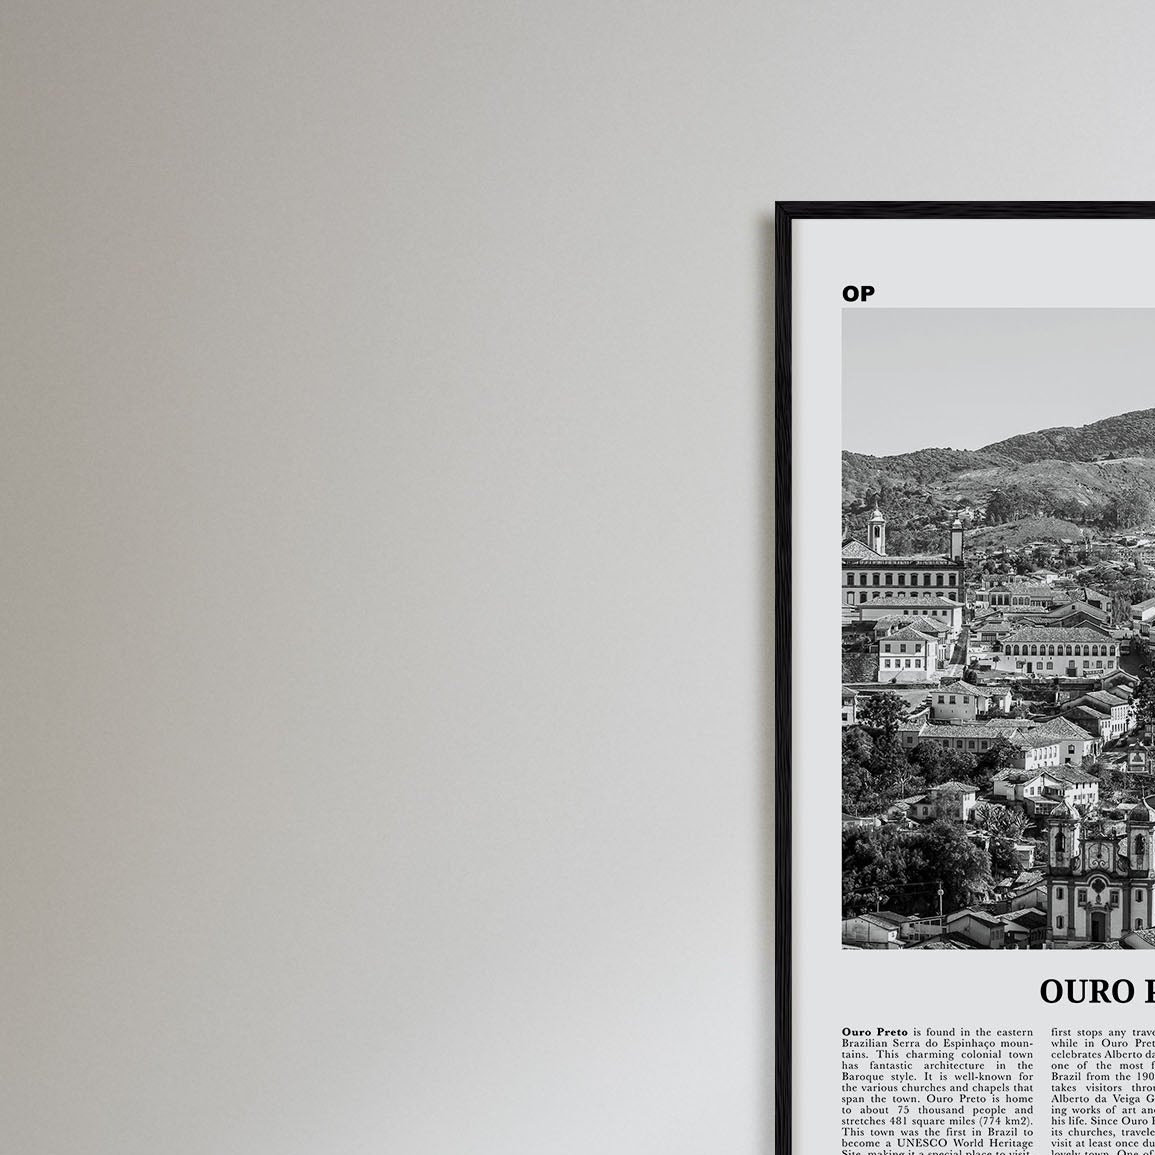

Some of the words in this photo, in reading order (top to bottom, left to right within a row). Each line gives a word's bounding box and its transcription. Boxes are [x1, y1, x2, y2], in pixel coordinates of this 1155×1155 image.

[842, 285, 875, 303] OP
[1040, 979, 1135, 1004] OURO
[842, 1028, 872, 1036] Ouro
[877, 1028, 909, 1036] Preto
[913, 1028, 922, 1036] is
[926, 1028, 956, 1036] found
[960, 1028, 971, 1036] in
[976, 1028, 992, 1036] the
[1051, 1028, 1071, 1036] first
[1077, 1029, 1103, 1039] stops
[1108, 1030, 1127, 1039] any
[842, 1039, 888, 1047] Brazilian
[893, 1039, 920, 1047] Serra
[925, 1039, 938, 1047] do
[943, 1039, 996, 1050] Espinhaço
[1051, 1039, 1078, 1047] while
[1085, 1039, 1095, 1047] in
[1101, 1039, 1129, 1047] Ouro
[842, 1050, 869, 1059] tains.
[876, 1050, 899, 1059] This
[906, 1050, 955, 1061] charming
[961, 1050, 1002, 1059] colonial
[1009, 1051, 1033, 1059] town
[1051, 1050, 1102, 1059] celebrates
[1104, 1050, 1143, 1059] Alberto
[842, 1061, 859, 1070] has
[870, 1061, 913, 1070] fantastic
[924, 1061, 985, 1070] architecture
[996, 1061, 1006, 1070] in
[1017, 1061, 1034, 1070] the
[842, 1072, 884, 1083] Baroque
[891, 1072, 917, 1083] style.
[924, 1072, 933, 1081] It
[940, 1072, 948, 1081] is
[954, 1072, 1012, 1081] well-known
[1019, 1072, 1034, 1081] for
[1052, 1072, 1081, 1081] Brazil
[1086, 1072, 1110, 1081] from
[1115, 1072, 1131, 1081] the
[842, 1083, 858, 1092] the
[861, 1083, 898, 1092] various
[901, 1083, 947, 1092] churches
[950, 1083, 969, 1092] and
[972, 1083, 1010, 1094] chapels
[1013, 1083, 1033, 1092] that
[1051, 1083, 1077, 1092] takes
[1086, 1083, 1123, 1092] visitors
[1051, 1094, 1090, 1103] Alberto
[1094, 1094, 1107, 1103] da
[1113, 1094, 1141, 1105] Veiga
[842, 1117, 886, 1125] stretches
[890, 1117, 907, 1125] 481
[912, 1119, 945, 1127] square
[949, 1117, 976, 1125] miles
[979, 1117, 1001, 1127] (774
[1005, 1117, 1033, 1127] km2).
[1051, 1128, 1063, 1136] its
[1068, 1128, 1116, 1137] churches,
[842, 1139, 880, 1147] become
[897, 1139, 948, 1147] UNESCO
[954, 1139, 984, 1147] World
[990, 1139, 1033, 1149] Heritage
